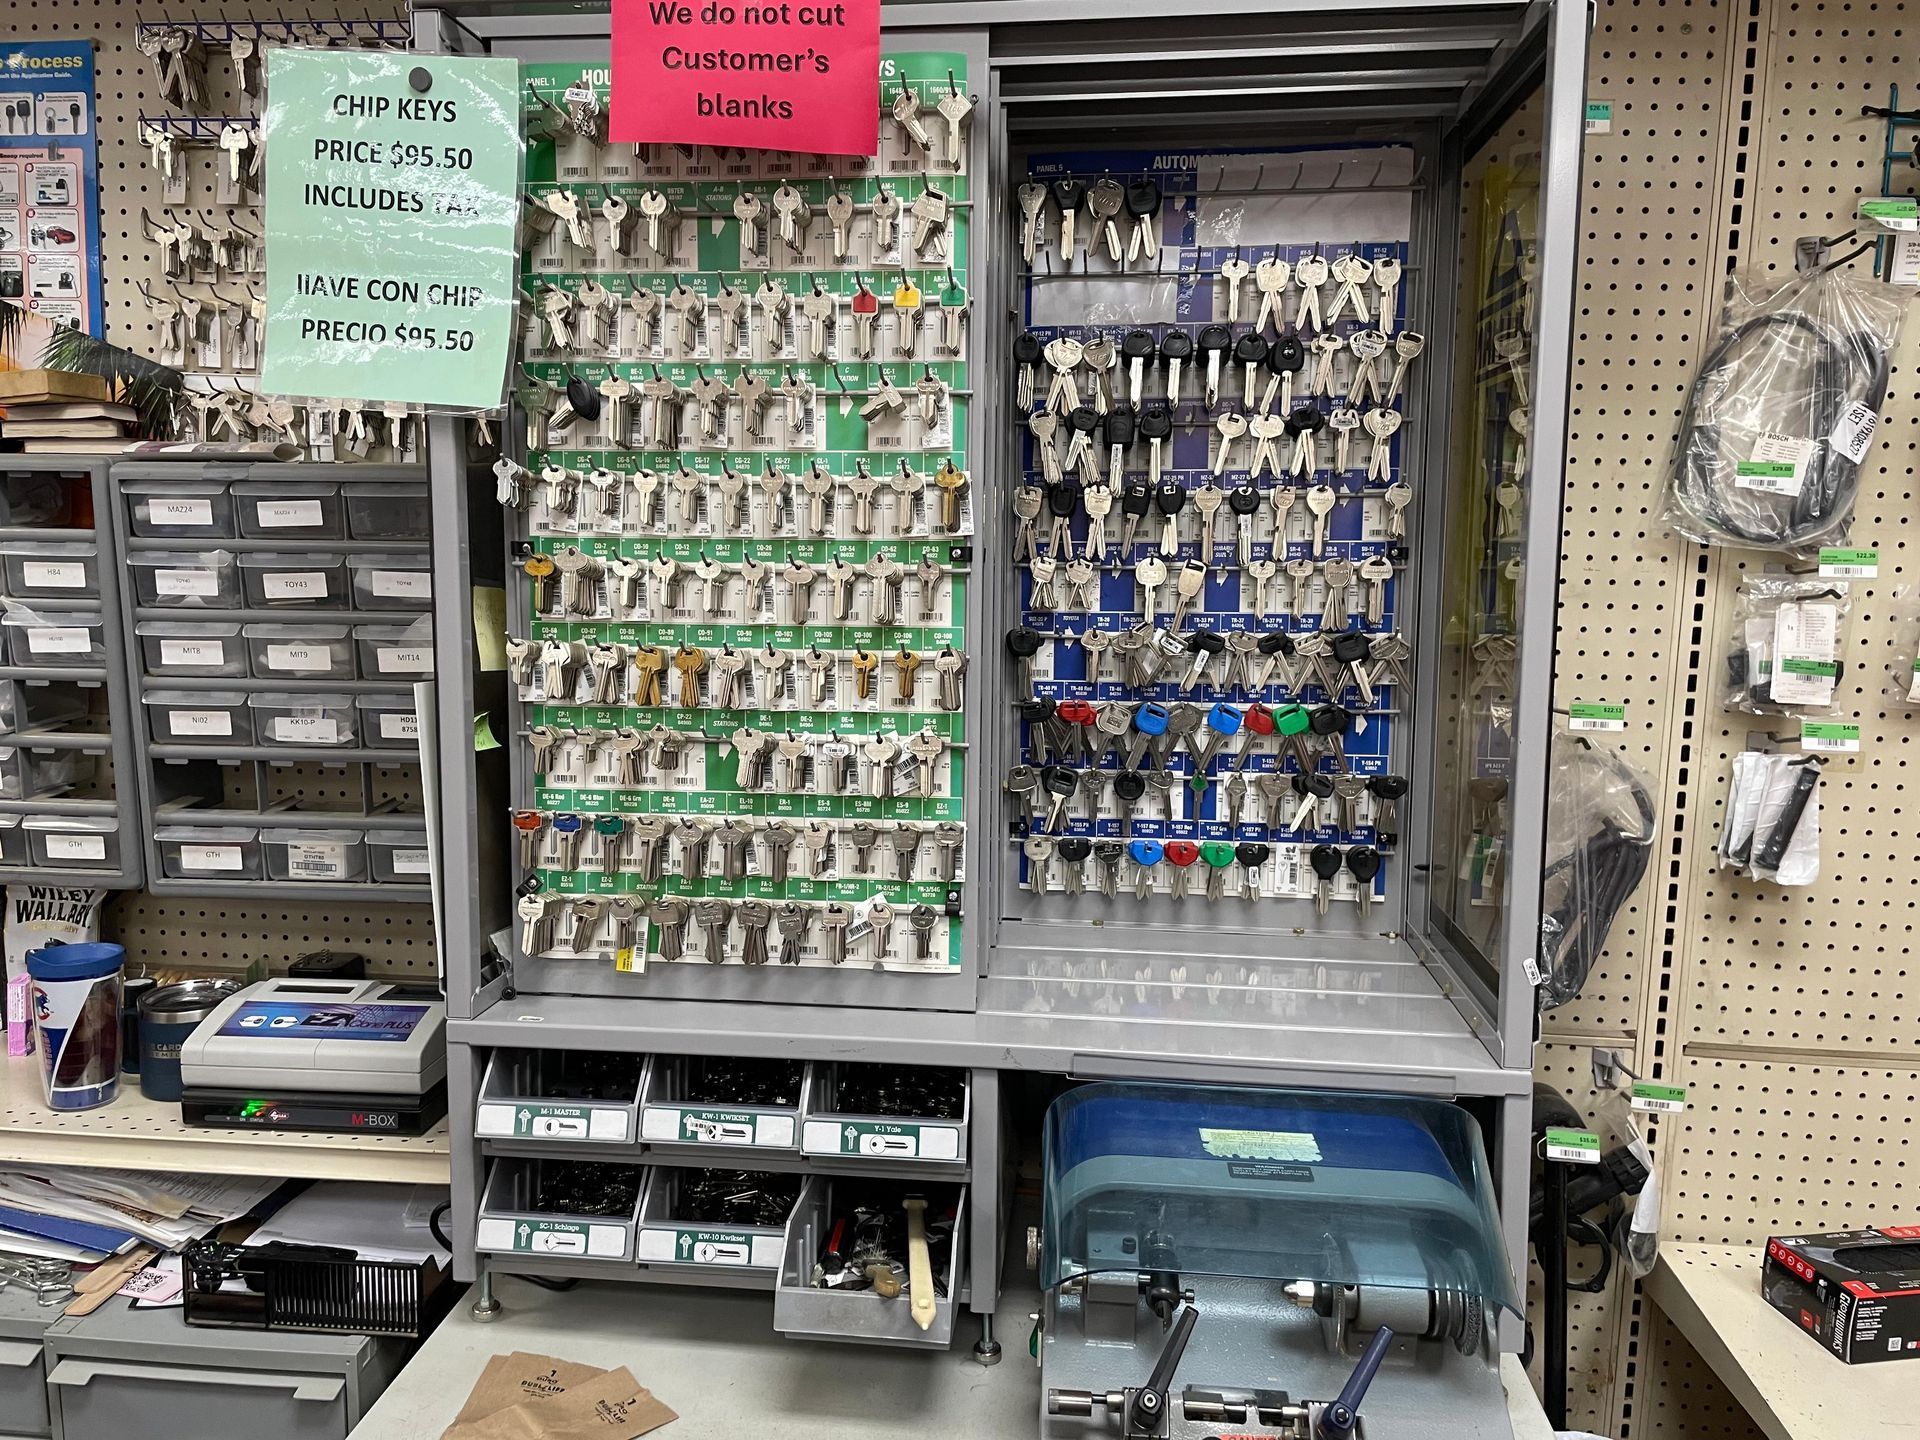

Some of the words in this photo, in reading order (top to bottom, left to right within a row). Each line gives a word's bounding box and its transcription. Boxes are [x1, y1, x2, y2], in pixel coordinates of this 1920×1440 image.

[651, 2, 692, 26] We
[700, 1, 736, 26] do
[743, 2, 790, 26] not
[798, 4, 846, 27] cut
[525, 77, 550, 86] PANEL
[551, 77, 556, 86] 1
[333, 94, 389, 117] CHIP
[398, 98, 458, 122] KEYS
[697, 93, 794, 120] blanks
[315, 139, 383, 163] PRICE
[390, 143, 473, 170] $95.50
[1036, 164, 1057, 173] PANEL
[305, 183, 424, 213] INCLUDES
[366, 279, 419, 303] CON
[427, 284, 484, 307] CHIP
[301, 318, 387, 345] PRECIO
[394, 322, 474, 351] $95.50
[1767, 432, 1790, 443] BOSCH
[167, 505, 193, 513] MAZ24
[47, 568, 61, 576] H84
[183, 647, 201, 655] MIT8
[289, 650, 308, 658] MIT9
[397, 654, 420, 662] MIT14
[290, 718, 316, 726] KK10-P
[68, 840, 83, 848] GTH
[205, 851, 221, 859] GTH
[28, 885, 96, 903] WILEY
[384, 1020, 416, 1030] PLUS
[541, 1107, 556, 1115] M-1
[556, 1108, 581, 1117] MASTER
[702, 1112, 722, 1121] KW-1
[722, 1113, 750, 1122] KWIKSET
[352, 1112, 396, 1127] M-BOX
[874, 1125, 885, 1133] Y-1
[886, 1126, 902, 1134] Yale
[539, 1223, 554, 1231] SC-1
[555, 1224, 580, 1233] Schlage
[698, 1233, 719, 1242] KW-10
[719, 1234, 746, 1243] Kwikset
